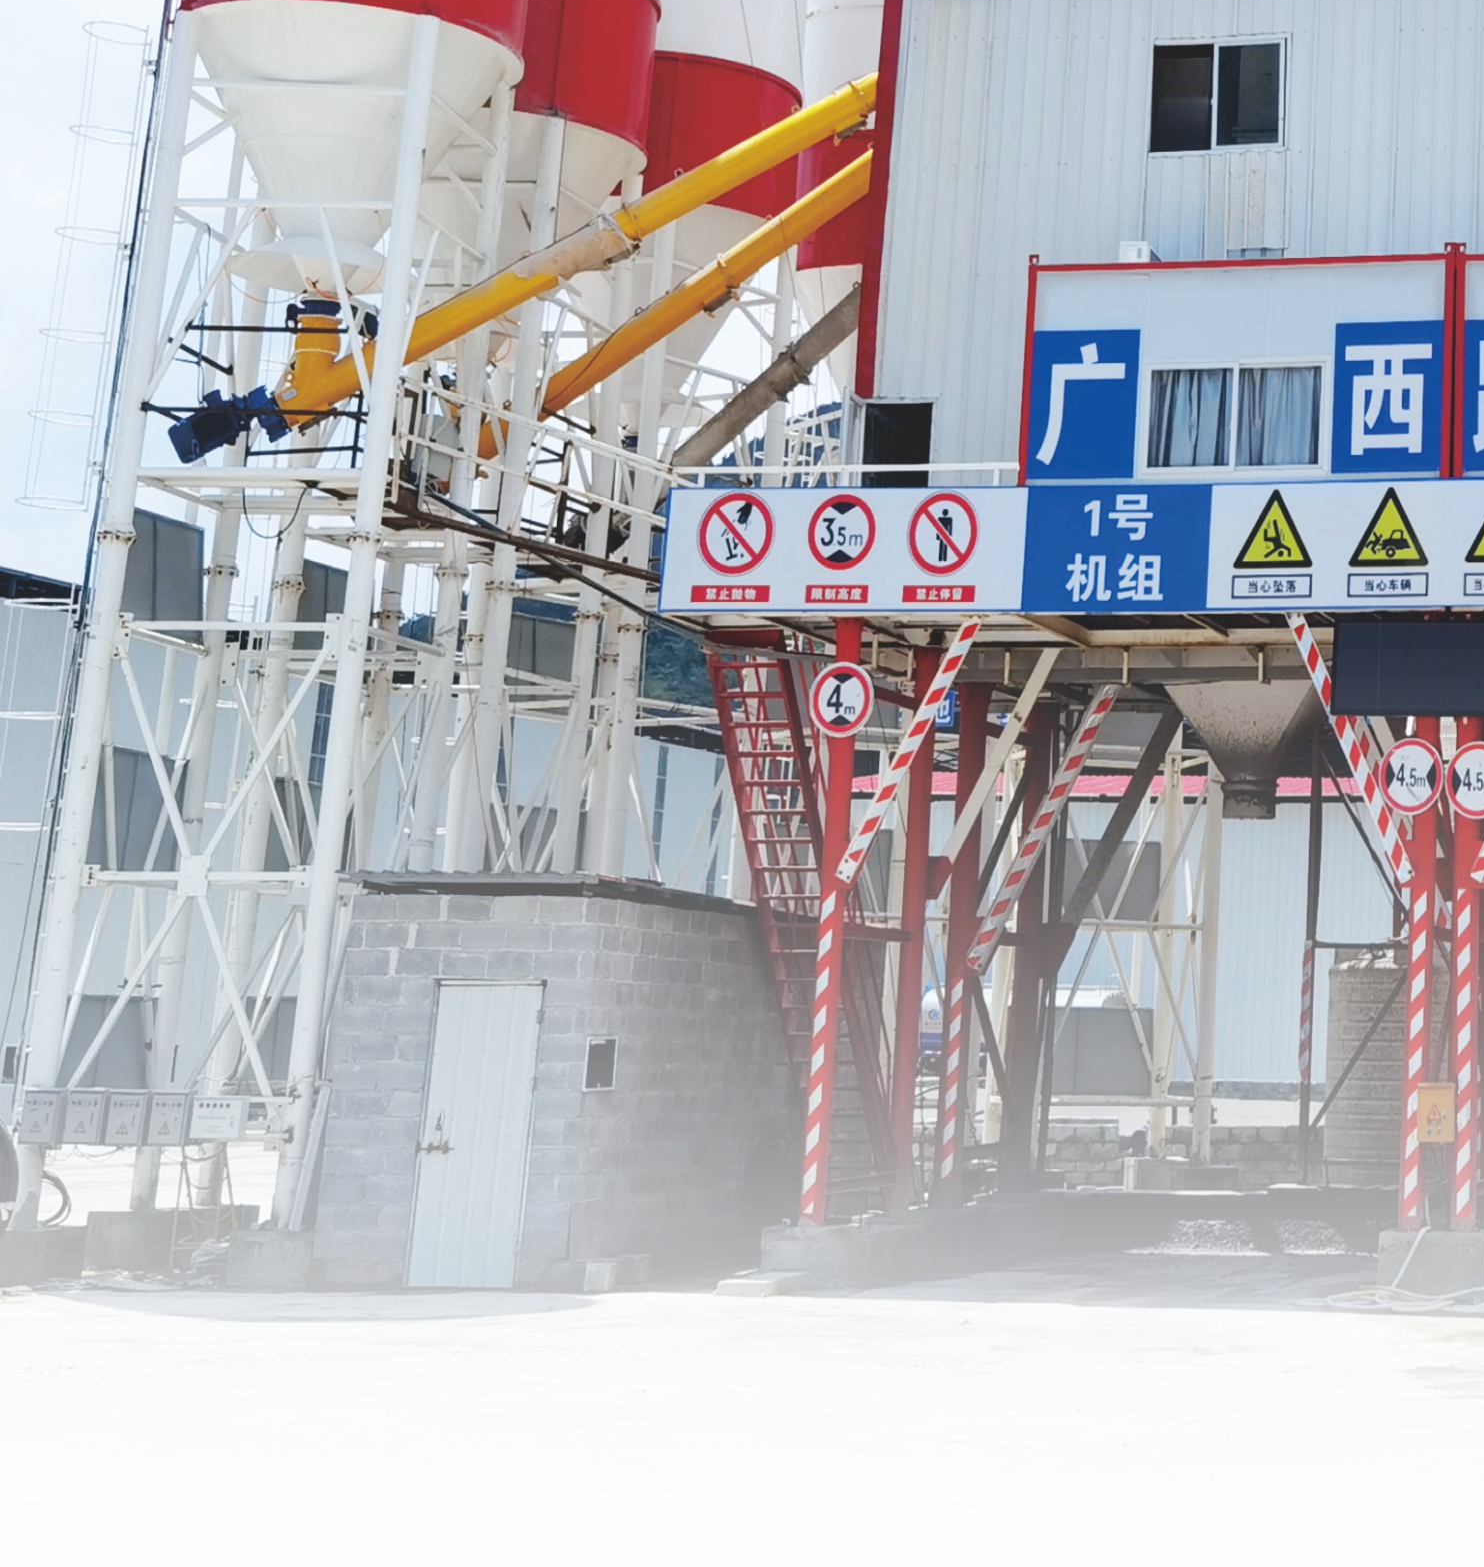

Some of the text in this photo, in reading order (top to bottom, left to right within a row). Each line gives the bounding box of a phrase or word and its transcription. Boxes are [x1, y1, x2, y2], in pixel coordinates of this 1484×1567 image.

[1083, 493, 1155, 541] 1号
[1066, 553, 1163, 603] 机组
[1247, 579, 1298, 594] 当心坠落
[1363, 578, 1413, 593] 当心车辆
[810, 587, 863, 602] 限制高度
[915, 587, 963, 601] 禁止停留
[826, 683, 856, 714] 4m
[1395, 762, 1427, 788] 4.5m
